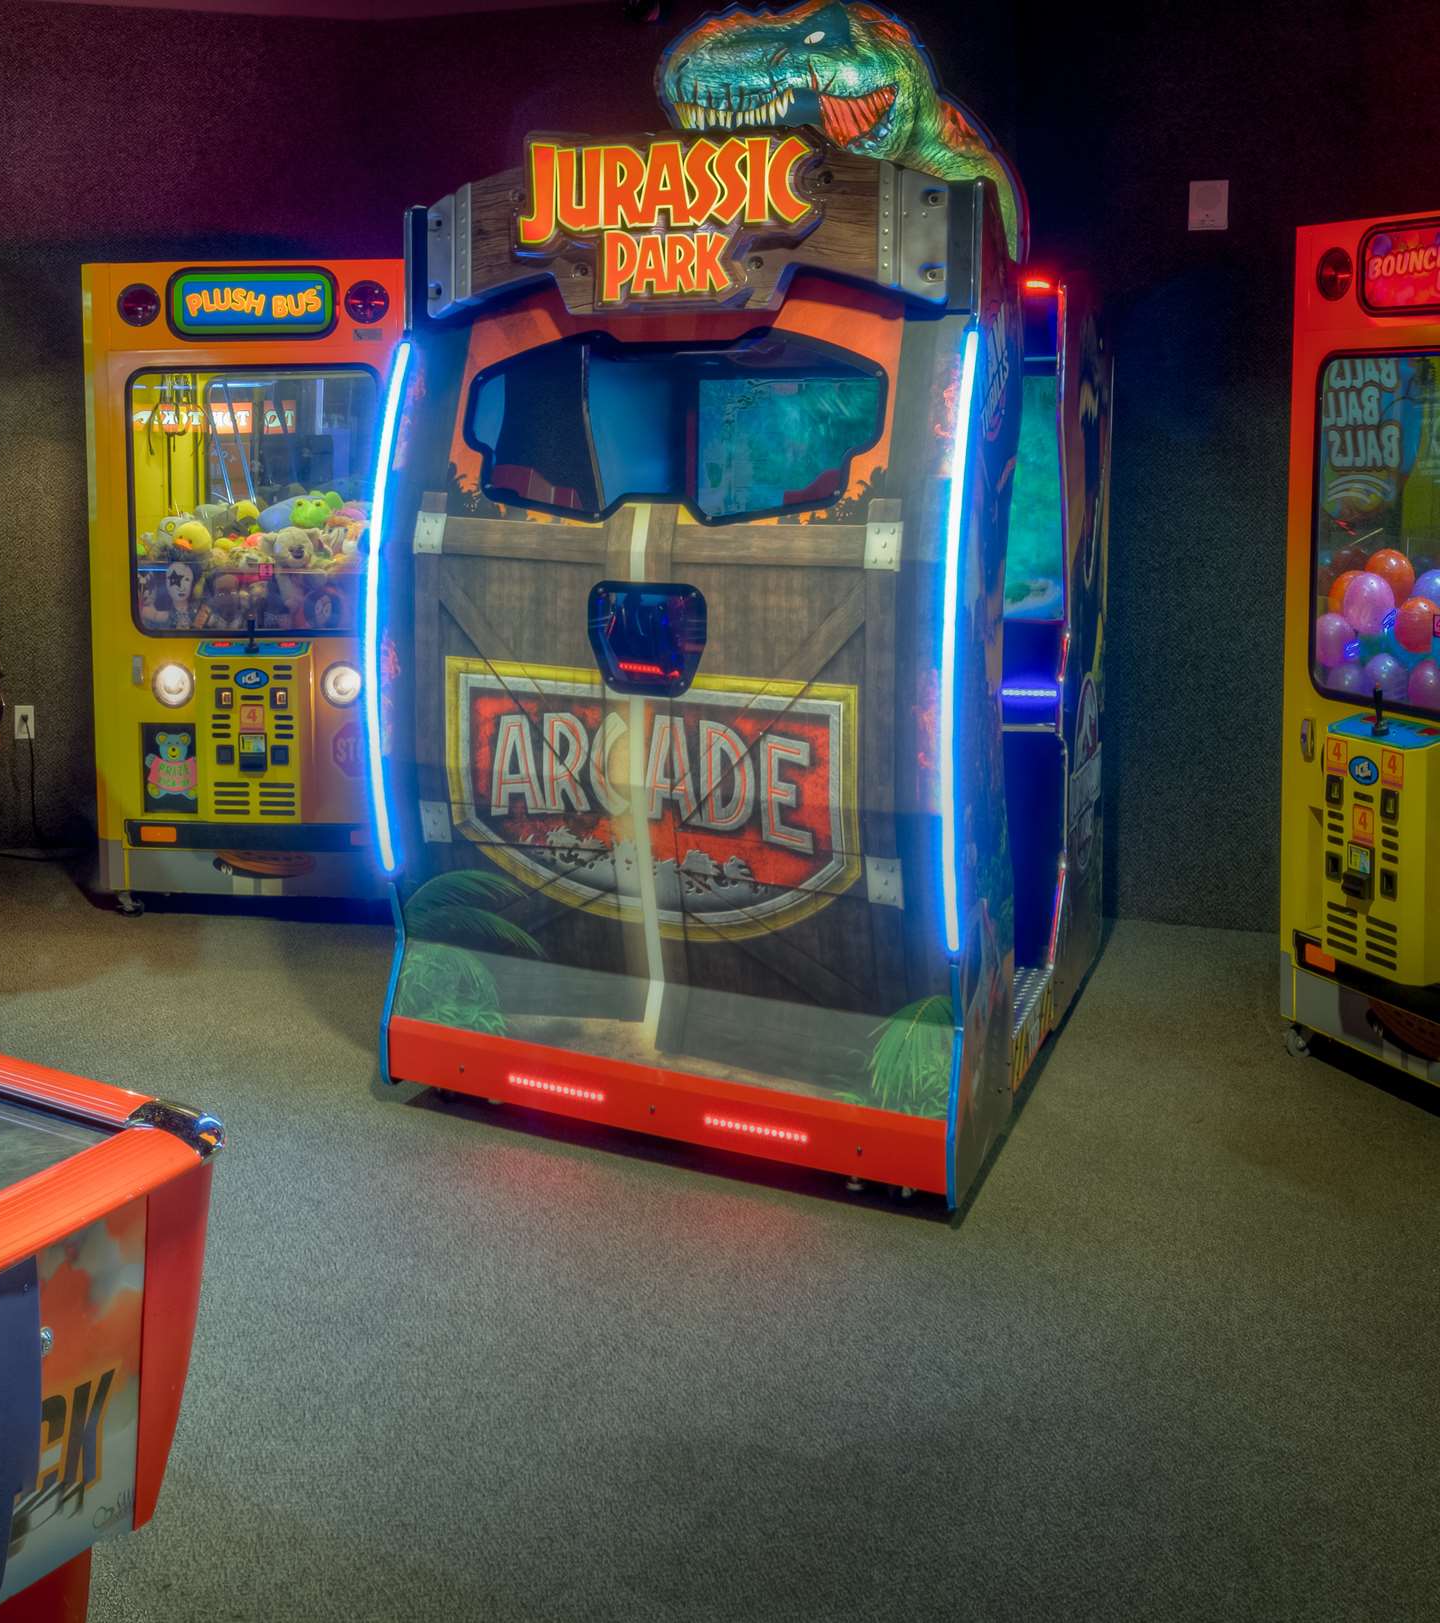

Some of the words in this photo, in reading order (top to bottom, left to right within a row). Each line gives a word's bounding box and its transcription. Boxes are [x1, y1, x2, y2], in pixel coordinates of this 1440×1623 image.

[519, 137, 812, 244] JURASSIC
[603, 229, 730, 302] PARK
[1368, 246, 1440, 281] BOUNC
[186, 287, 266, 318] PLUSH
[272, 289, 322, 318] BUS
[246, 708, 257, 722] 4
[1332, 743, 1342, 761] 4
[1387, 754, 1397, 774] 4
[490, 711, 815, 855] ARCADE
[1359, 811, 1368, 831] 4
